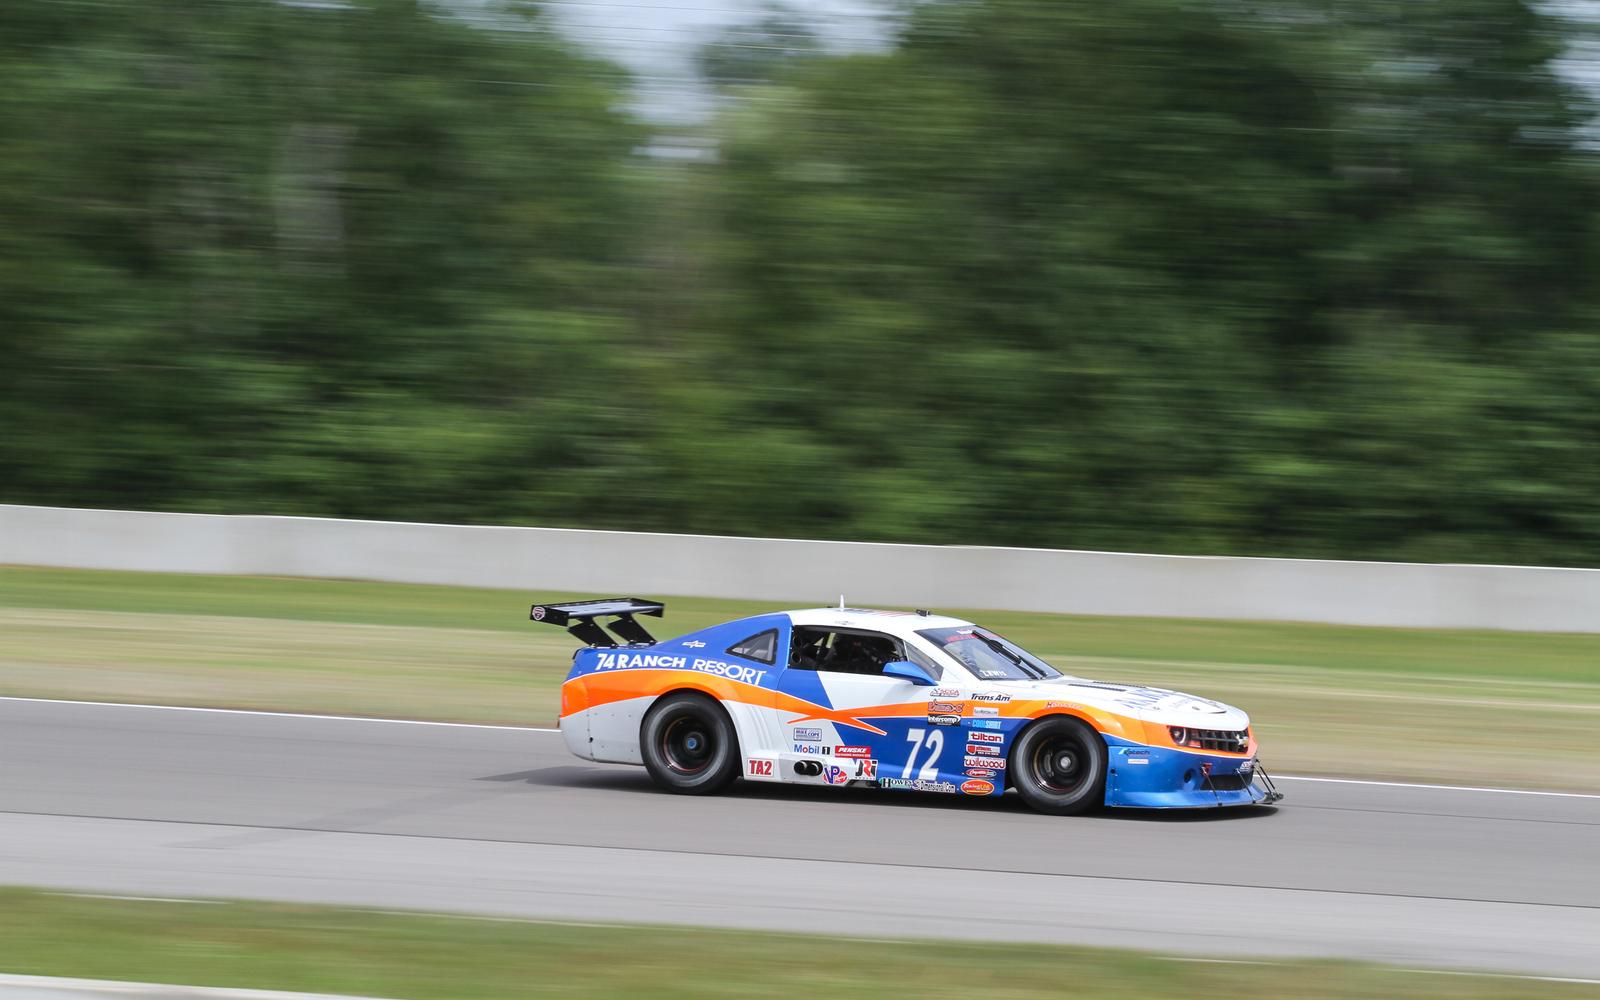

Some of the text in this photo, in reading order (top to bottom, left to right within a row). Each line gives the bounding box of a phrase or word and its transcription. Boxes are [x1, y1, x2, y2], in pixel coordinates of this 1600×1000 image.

[595, 653, 767, 686] 74 RANCH RESORT
[971, 693, 1011, 702] Trans Am
[971, 732, 1002, 742] tilton
[794, 744, 820, 754] Mobil
[902, 728, 944, 780] 72
[749, 760, 772, 775] TA2
[965, 757, 1005, 769] wilwood
[824, 766, 840, 784] VP
